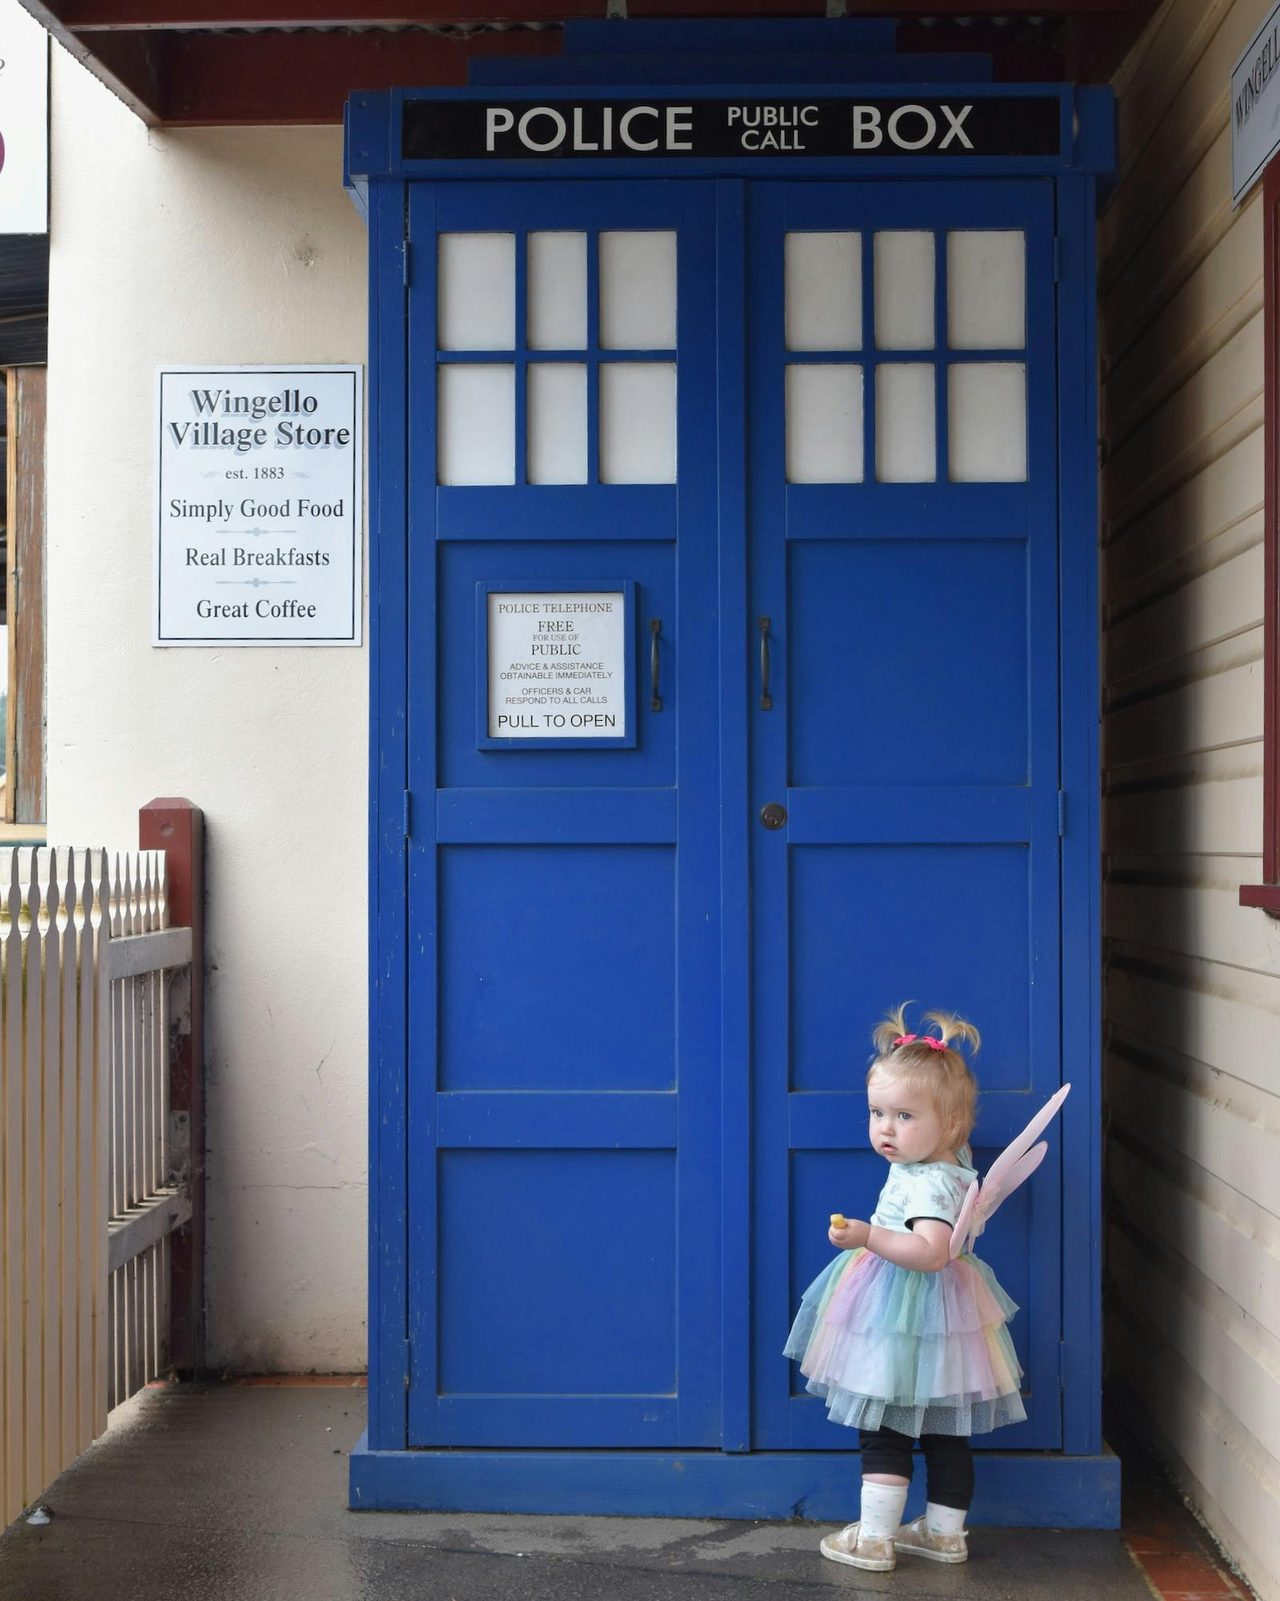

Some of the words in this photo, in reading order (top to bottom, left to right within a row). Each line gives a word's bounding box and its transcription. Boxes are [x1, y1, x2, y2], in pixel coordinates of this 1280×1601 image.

[727, 105, 819, 127] PUBLIC
[486, 106, 693, 151] POLICE
[852, 104, 975, 149] BOX
[740, 129, 805, 150] CALL
[191, 389, 318, 419] Wingello
[169, 422, 267, 452] Village
[277, 421, 351, 446] Store
[225, 469, 248, 480] est.
[253, 467, 285, 480] 1883
[170, 499, 234, 522] Simply
[240, 499, 290, 518] Good
[297, 499, 345, 518] Food
[185, 548, 226, 566] Real
[233, 547, 330, 566] Breakfasts
[196, 600, 249, 618] Great
[255, 600, 317, 618] Coffee
[499, 603, 540, 614] POLICE
[543, 603, 613, 613] TELEPHONE
[538, 621, 574, 632] FREE
[532, 634, 549, 642] FOR
[550, 634, 566, 642] USE
[568, 634, 579, 642] OF
[531, 644, 581, 656] PUBLIC
[510, 663, 541, 671] ADVICE
[543, 662, 549, 671] &
[551, 662, 604, 670] ASSISTANCE
[500, 672, 554, 680] OBTAINABLE
[555, 671, 613, 680] IMMEDIATELY
[521, 687, 564, 696] OFFICERS
[565, 687, 572, 695] &
[573, 687, 592, 695] CAR
[505, 696, 547, 705] RESPOND
[549, 696, 561, 704] TO
[563, 696, 578, 704] ALL
[580, 696, 608, 704] CALLS
[498, 715, 540, 728] PULL
[543, 714, 566, 728] TO
[570, 714, 616, 728] OPEN
